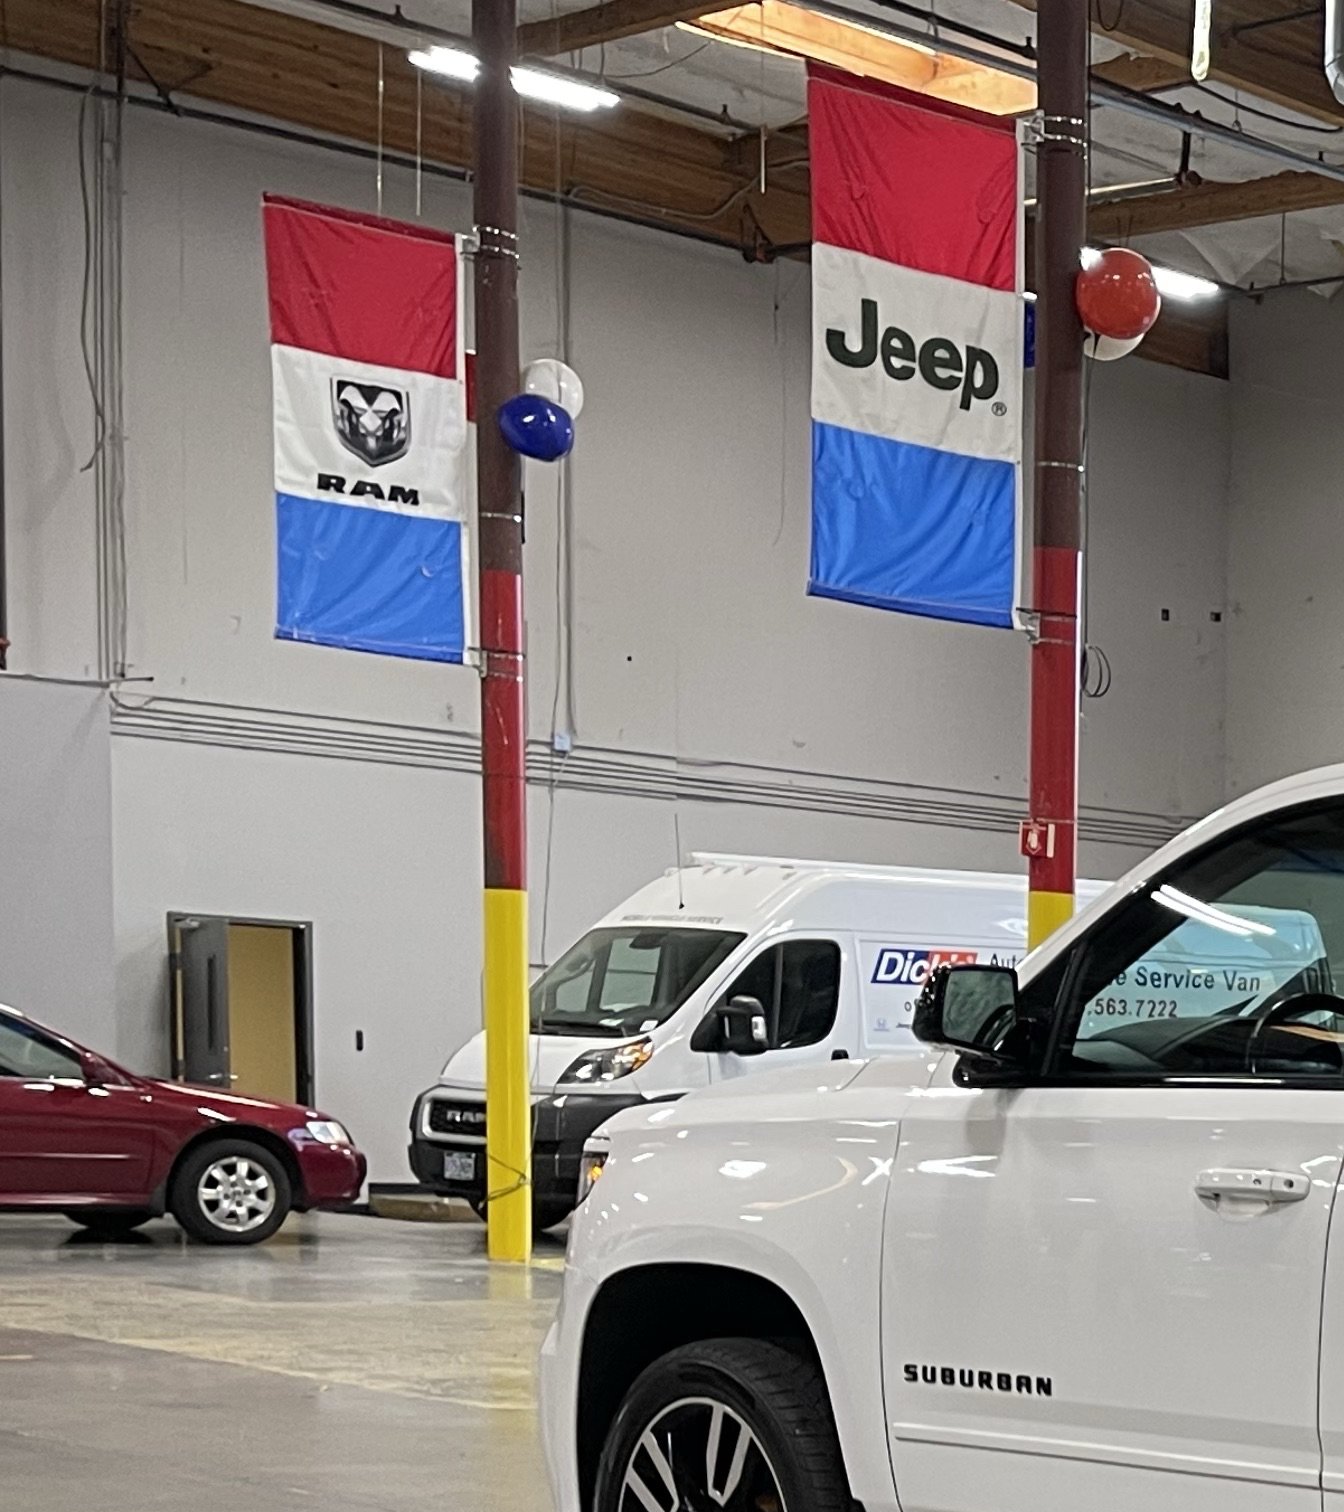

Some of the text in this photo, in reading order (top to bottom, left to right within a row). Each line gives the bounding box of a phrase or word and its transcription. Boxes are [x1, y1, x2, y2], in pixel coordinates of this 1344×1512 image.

[826, 298, 999, 411] Jeep
[317, 473, 420, 506] RAM
[1135, 966, 1215, 988] Service
[1223, 970, 1261, 991] Van
[1087, 997, 1178, 1018] .563.7222
[903, 1363, 1052, 1397] SUBURBAN
